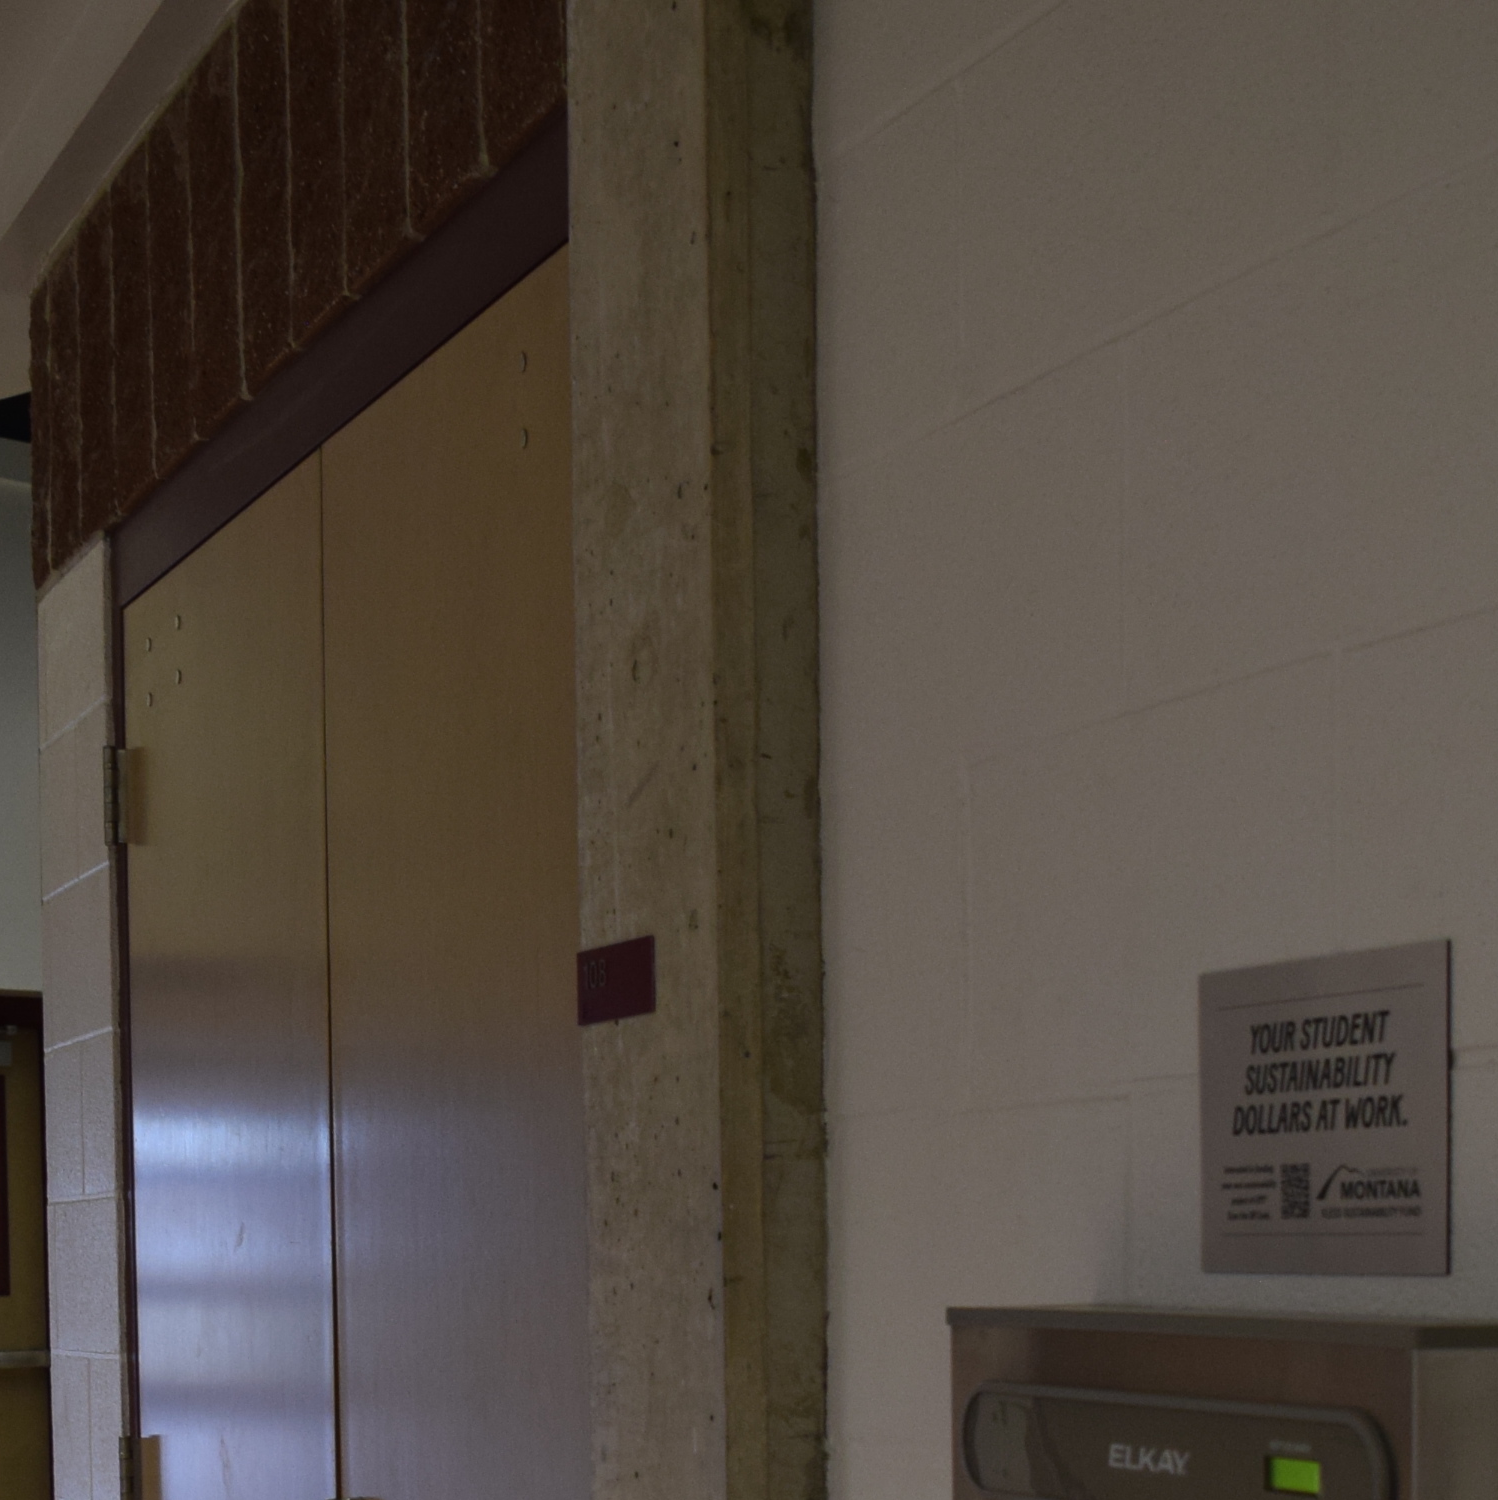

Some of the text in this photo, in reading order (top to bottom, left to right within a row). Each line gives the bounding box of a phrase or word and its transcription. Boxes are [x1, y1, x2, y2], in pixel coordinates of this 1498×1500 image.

[583, 960, 606, 988] 108
[1250, 1011, 1390, 1055] YOUR STUDENT
[1245, 1053, 1395, 1095] SUSTAINABILITY
[1232, 1094, 1409, 1137] DOLLARS AT WORK.
[1340, 1179, 1422, 1201] MONTANA
[1108, 1442, 1191, 1475] ELKAY
